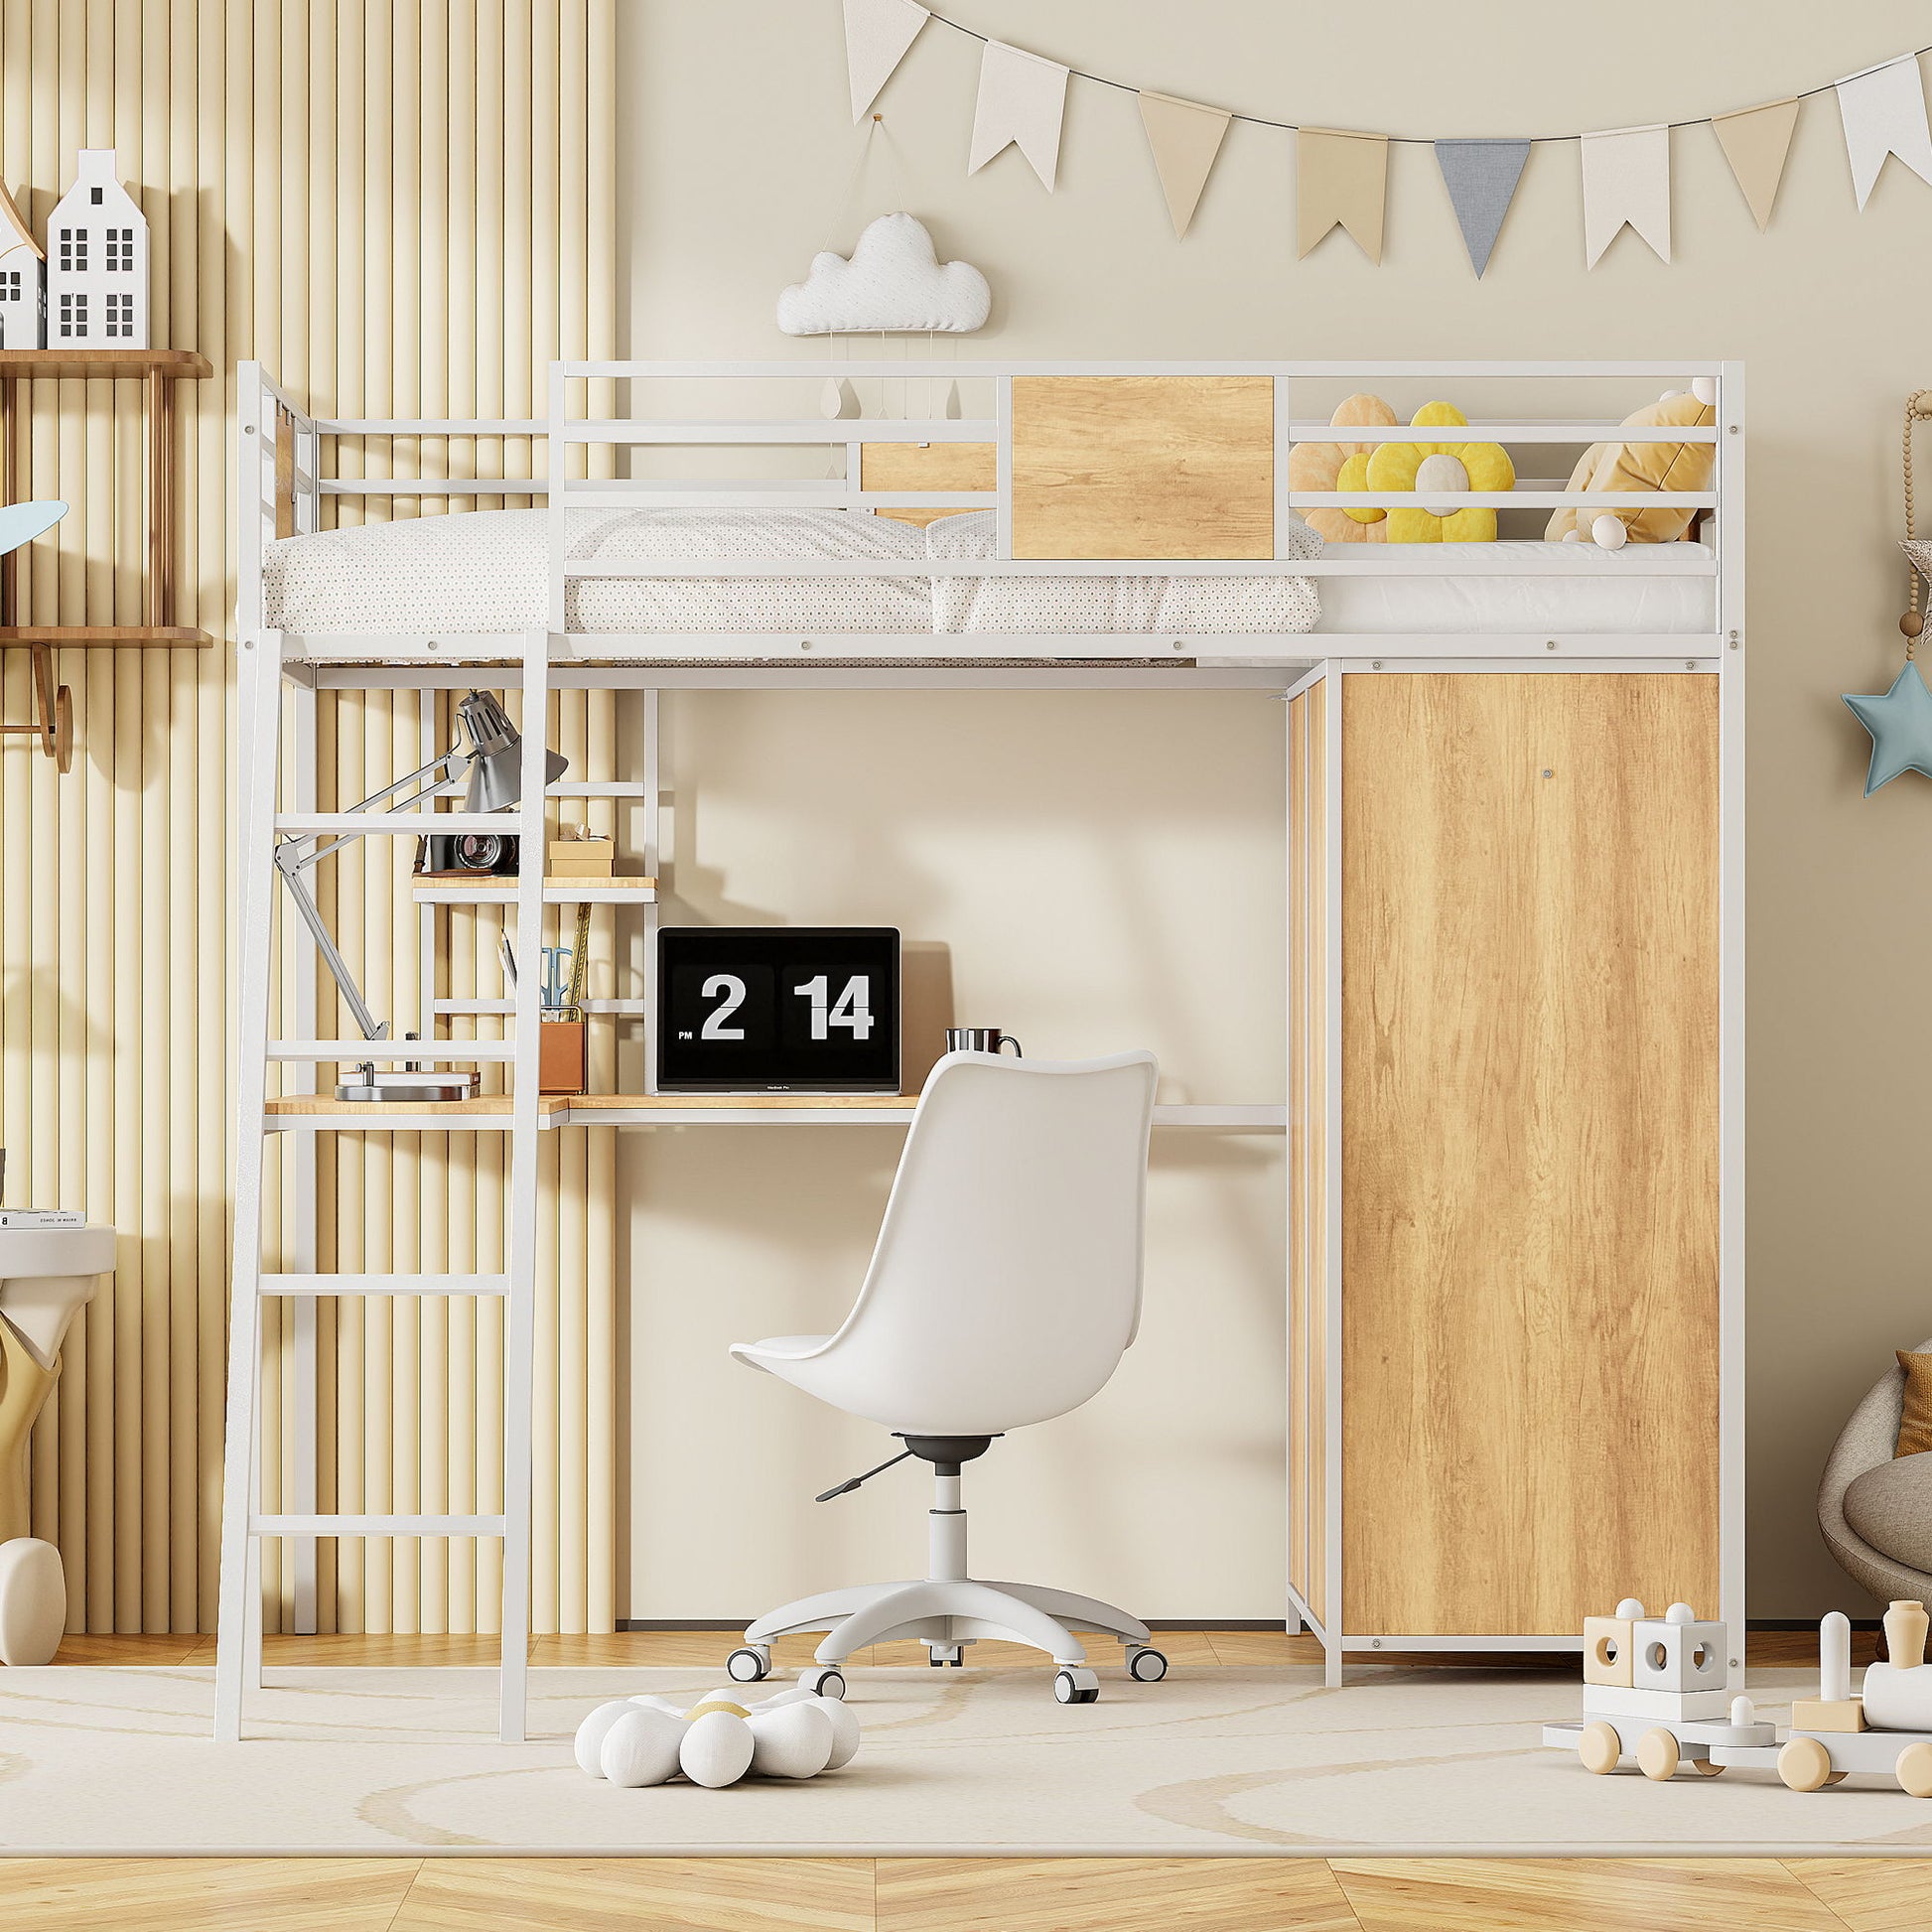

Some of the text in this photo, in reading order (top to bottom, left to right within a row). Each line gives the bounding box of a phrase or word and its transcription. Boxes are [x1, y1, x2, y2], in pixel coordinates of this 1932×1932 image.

[678, 974, 875, 1040] PM 2 14
